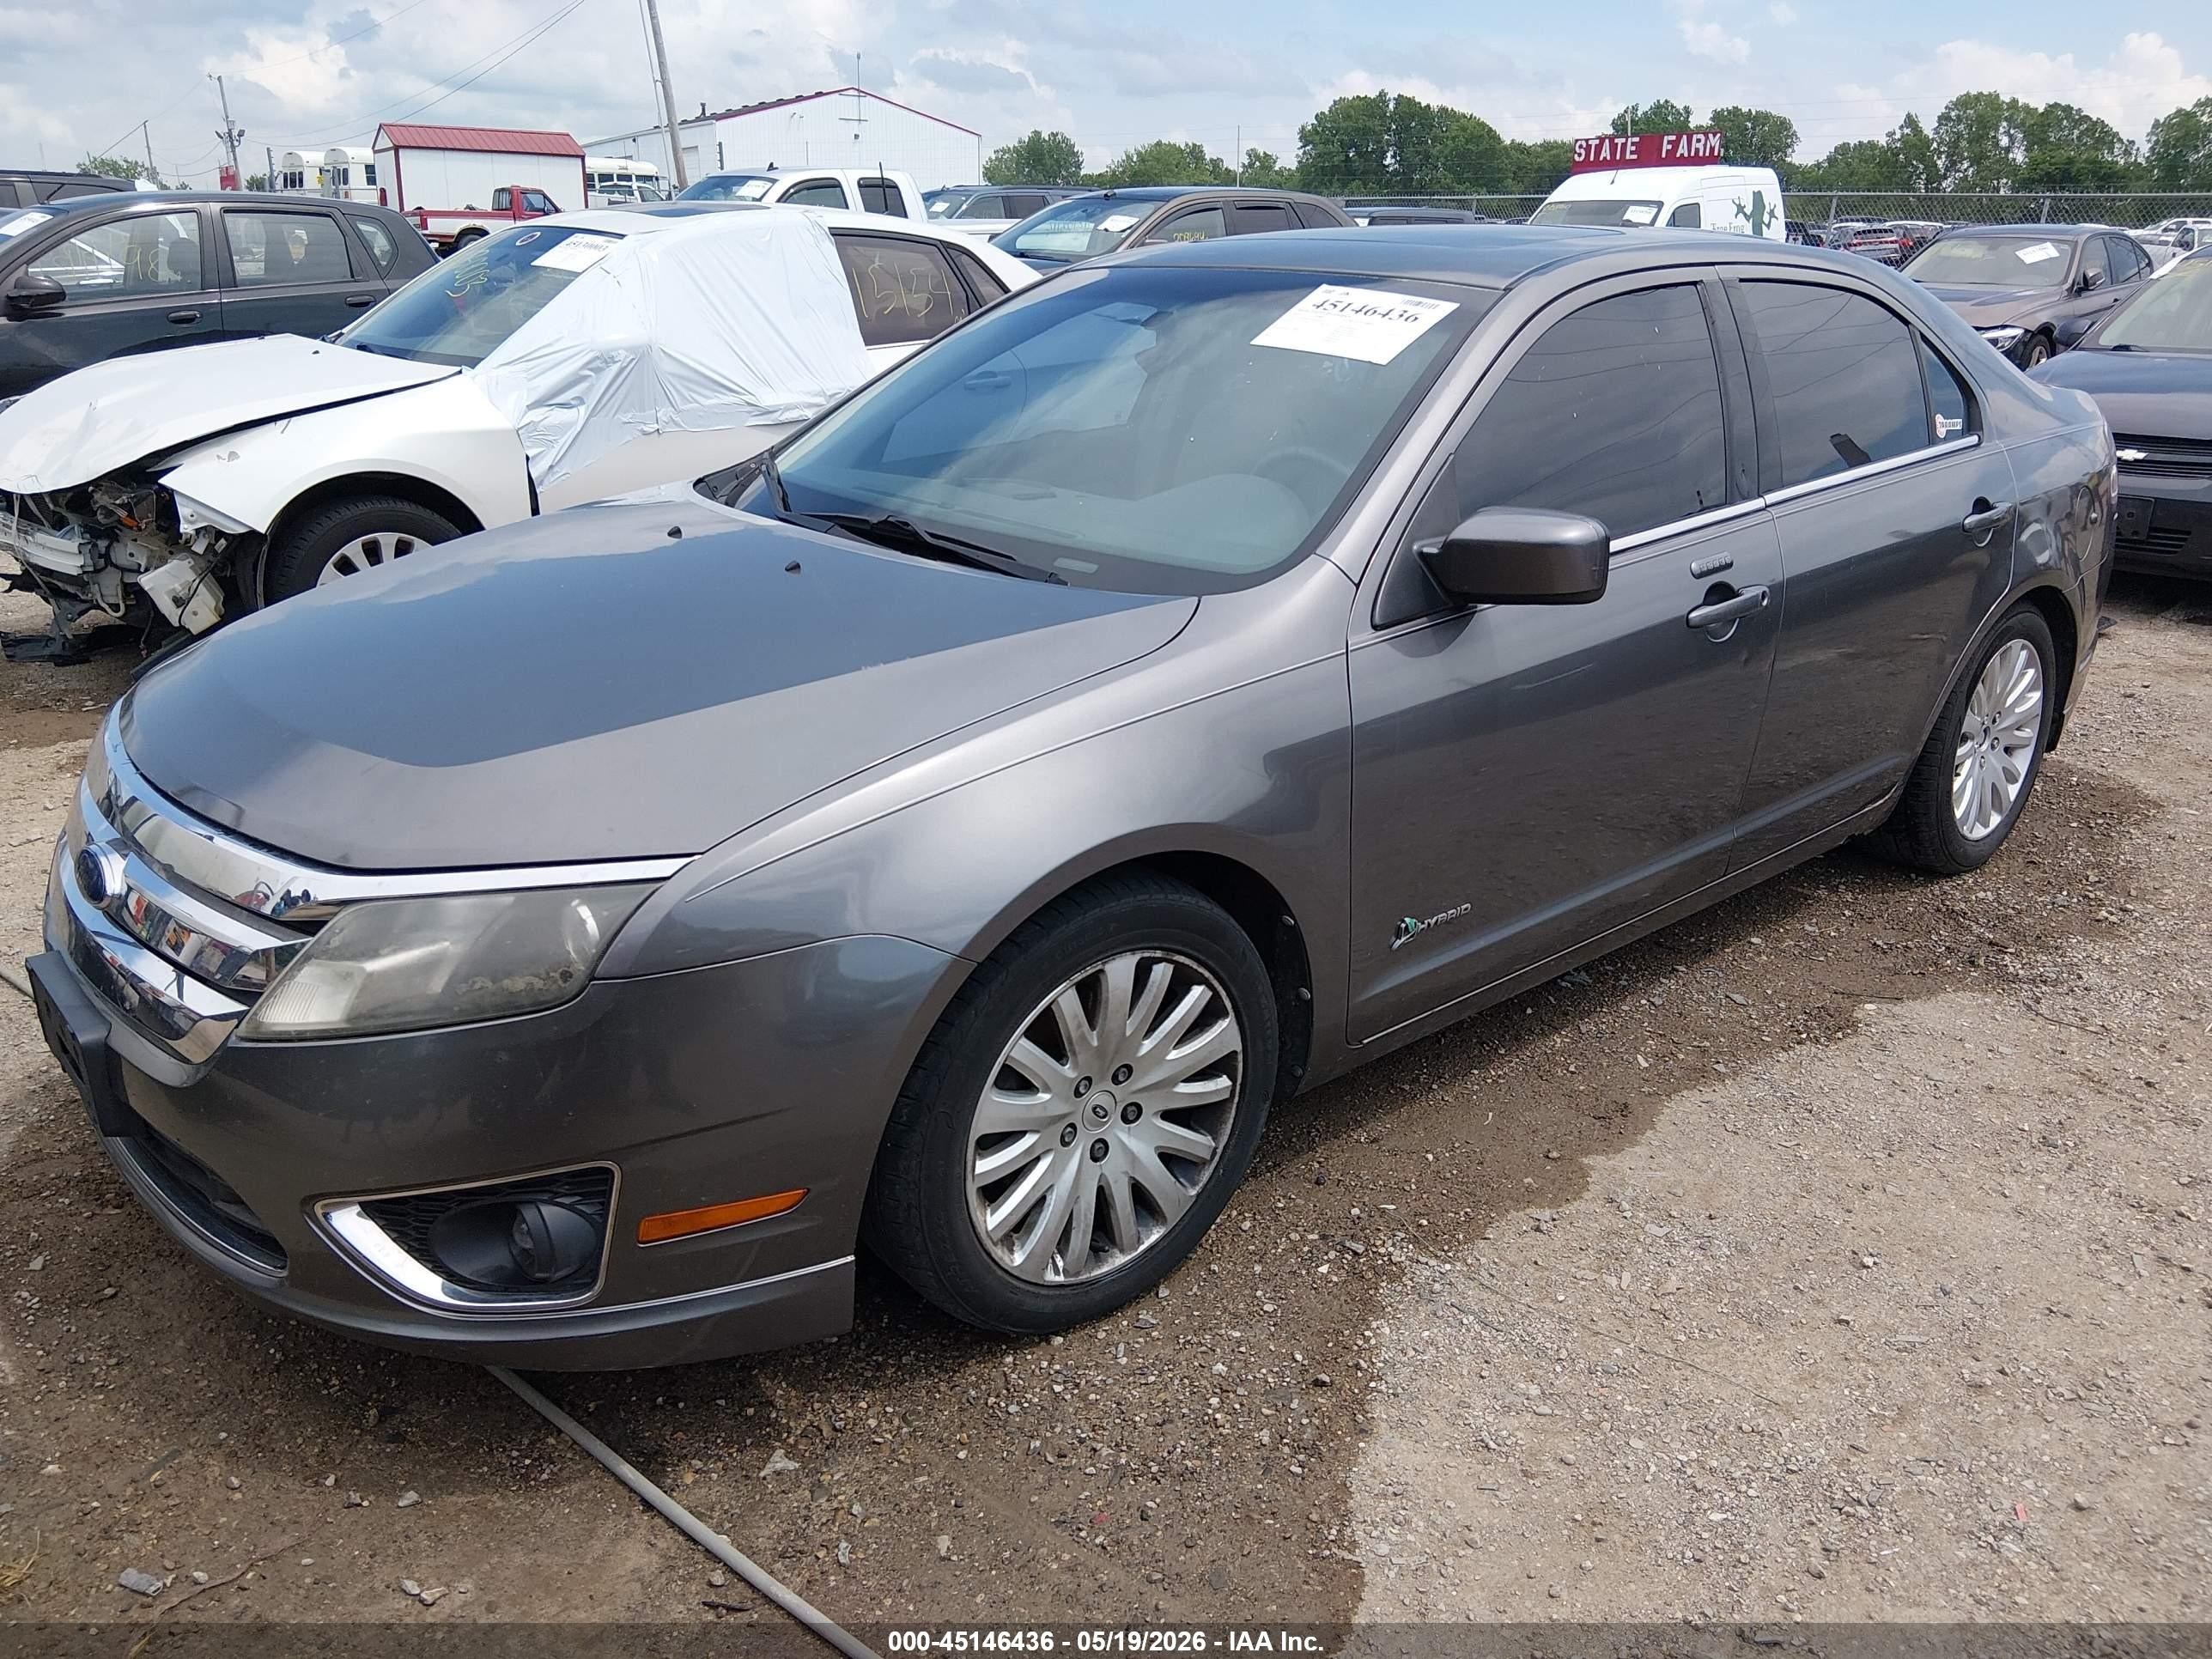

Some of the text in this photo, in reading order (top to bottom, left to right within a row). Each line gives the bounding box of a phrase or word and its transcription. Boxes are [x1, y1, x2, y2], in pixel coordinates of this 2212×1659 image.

[1573, 137, 1640, 162] STATE
[852, 261, 953, 318] 15154
[1312, 300, 1420, 324] 45146436
[1418, 902, 1472, 933] HYBRID
